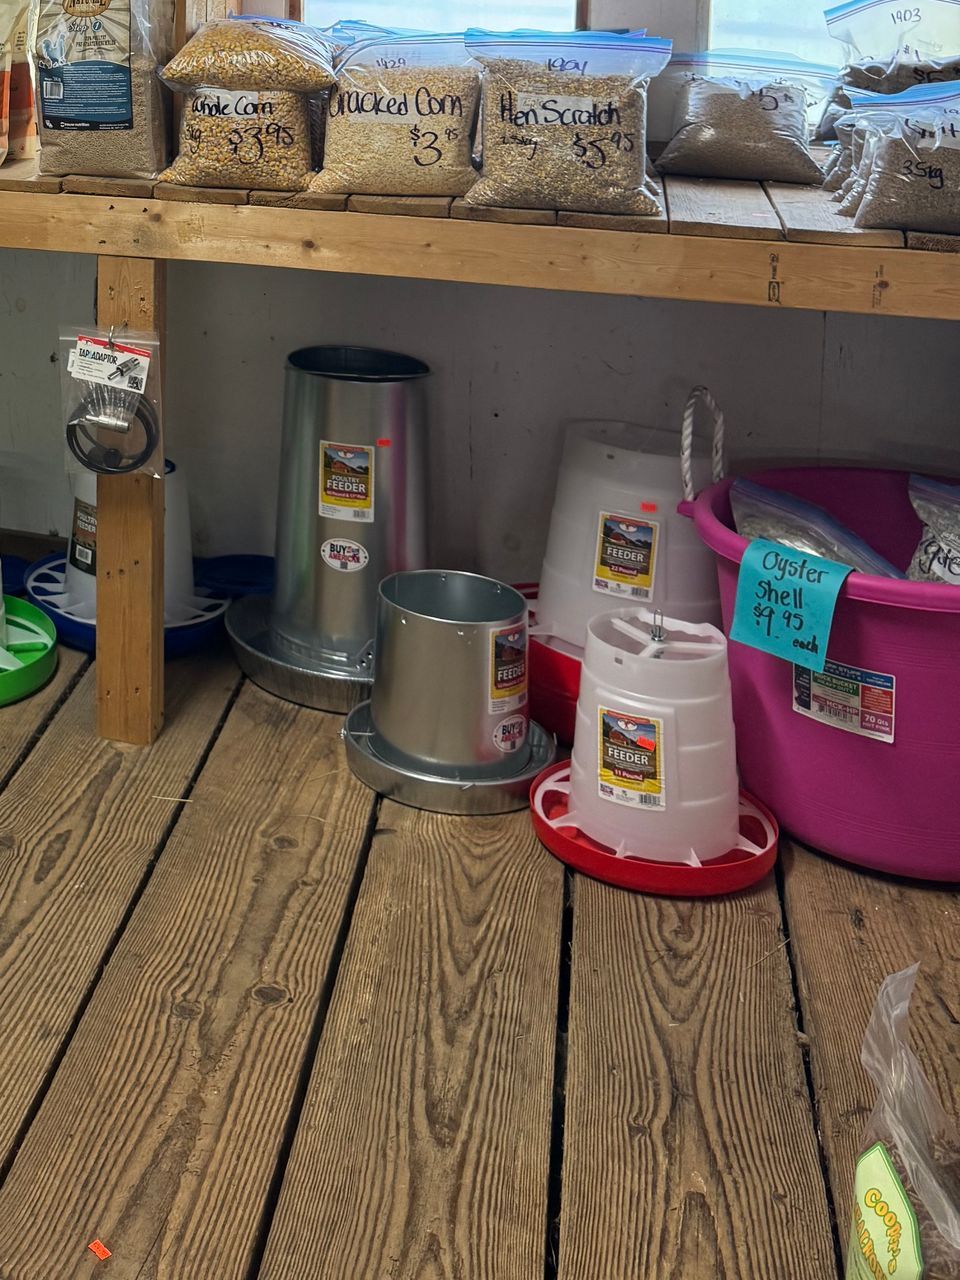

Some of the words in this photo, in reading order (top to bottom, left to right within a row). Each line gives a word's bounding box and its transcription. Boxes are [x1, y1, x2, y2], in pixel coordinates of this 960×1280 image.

[891, 7, 922, 25] 1903
[67, 21, 87, 33] Step
[192, 95, 231, 116] Whole
[234, 96, 274, 116] Corn
[329, 82, 409, 117] Cracked
[415, 86, 463, 118] Corn
[500, 90, 539, 127] Hen
[541, 99, 622, 126] Scratch
[91, 350, 118, 365] ADAPTOR
[326, 479, 366, 493] FEEDER
[331, 474, 360, 483] POULTRY
[330, 543, 347, 554] BUY
[607, 547, 645, 562] FEEDER
[328, 552, 361, 564] AMERICAN
[761, 549, 830, 585] Oyster
[754, 580, 804, 610] Shell
[792, 634, 819, 655] each
[864, 714, 876, 723] 70
[607, 747, 649, 765] FEEDER
[622, 771, 643, 781] Pound
